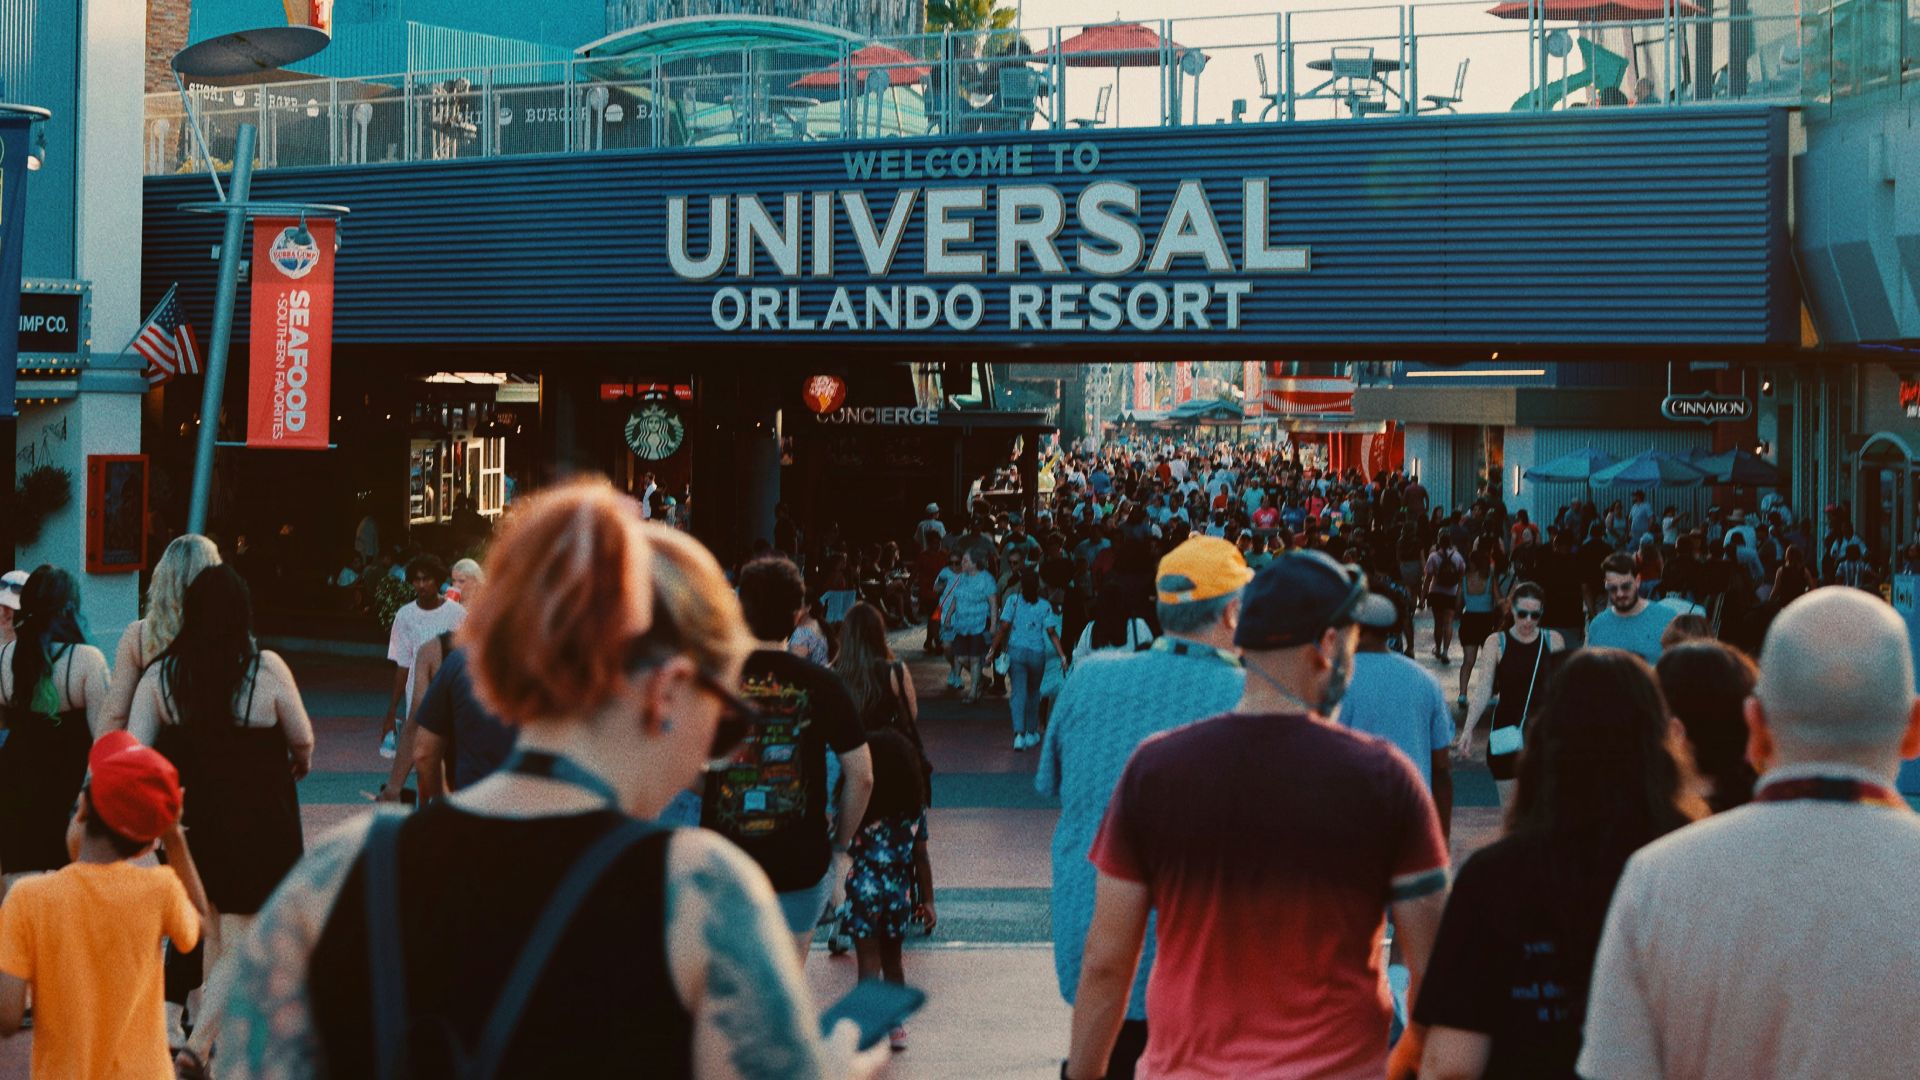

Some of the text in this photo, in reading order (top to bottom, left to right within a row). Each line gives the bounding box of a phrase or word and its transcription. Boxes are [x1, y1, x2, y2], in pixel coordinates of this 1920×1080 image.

[844, 142, 1100, 182] WELCOME TO
[666, 177, 1311, 282] UNIVERSAL
[46, 315, 69, 333] CO.
[711, 281, 1254, 333] ORLANDO RESORT
[286, 289, 310, 433] SEAFOOD
[272, 370, 287, 440] FAVORITES
[816, 406, 939, 425] CONCIERGE
[1671, 401, 1745, 416] CINNABON
